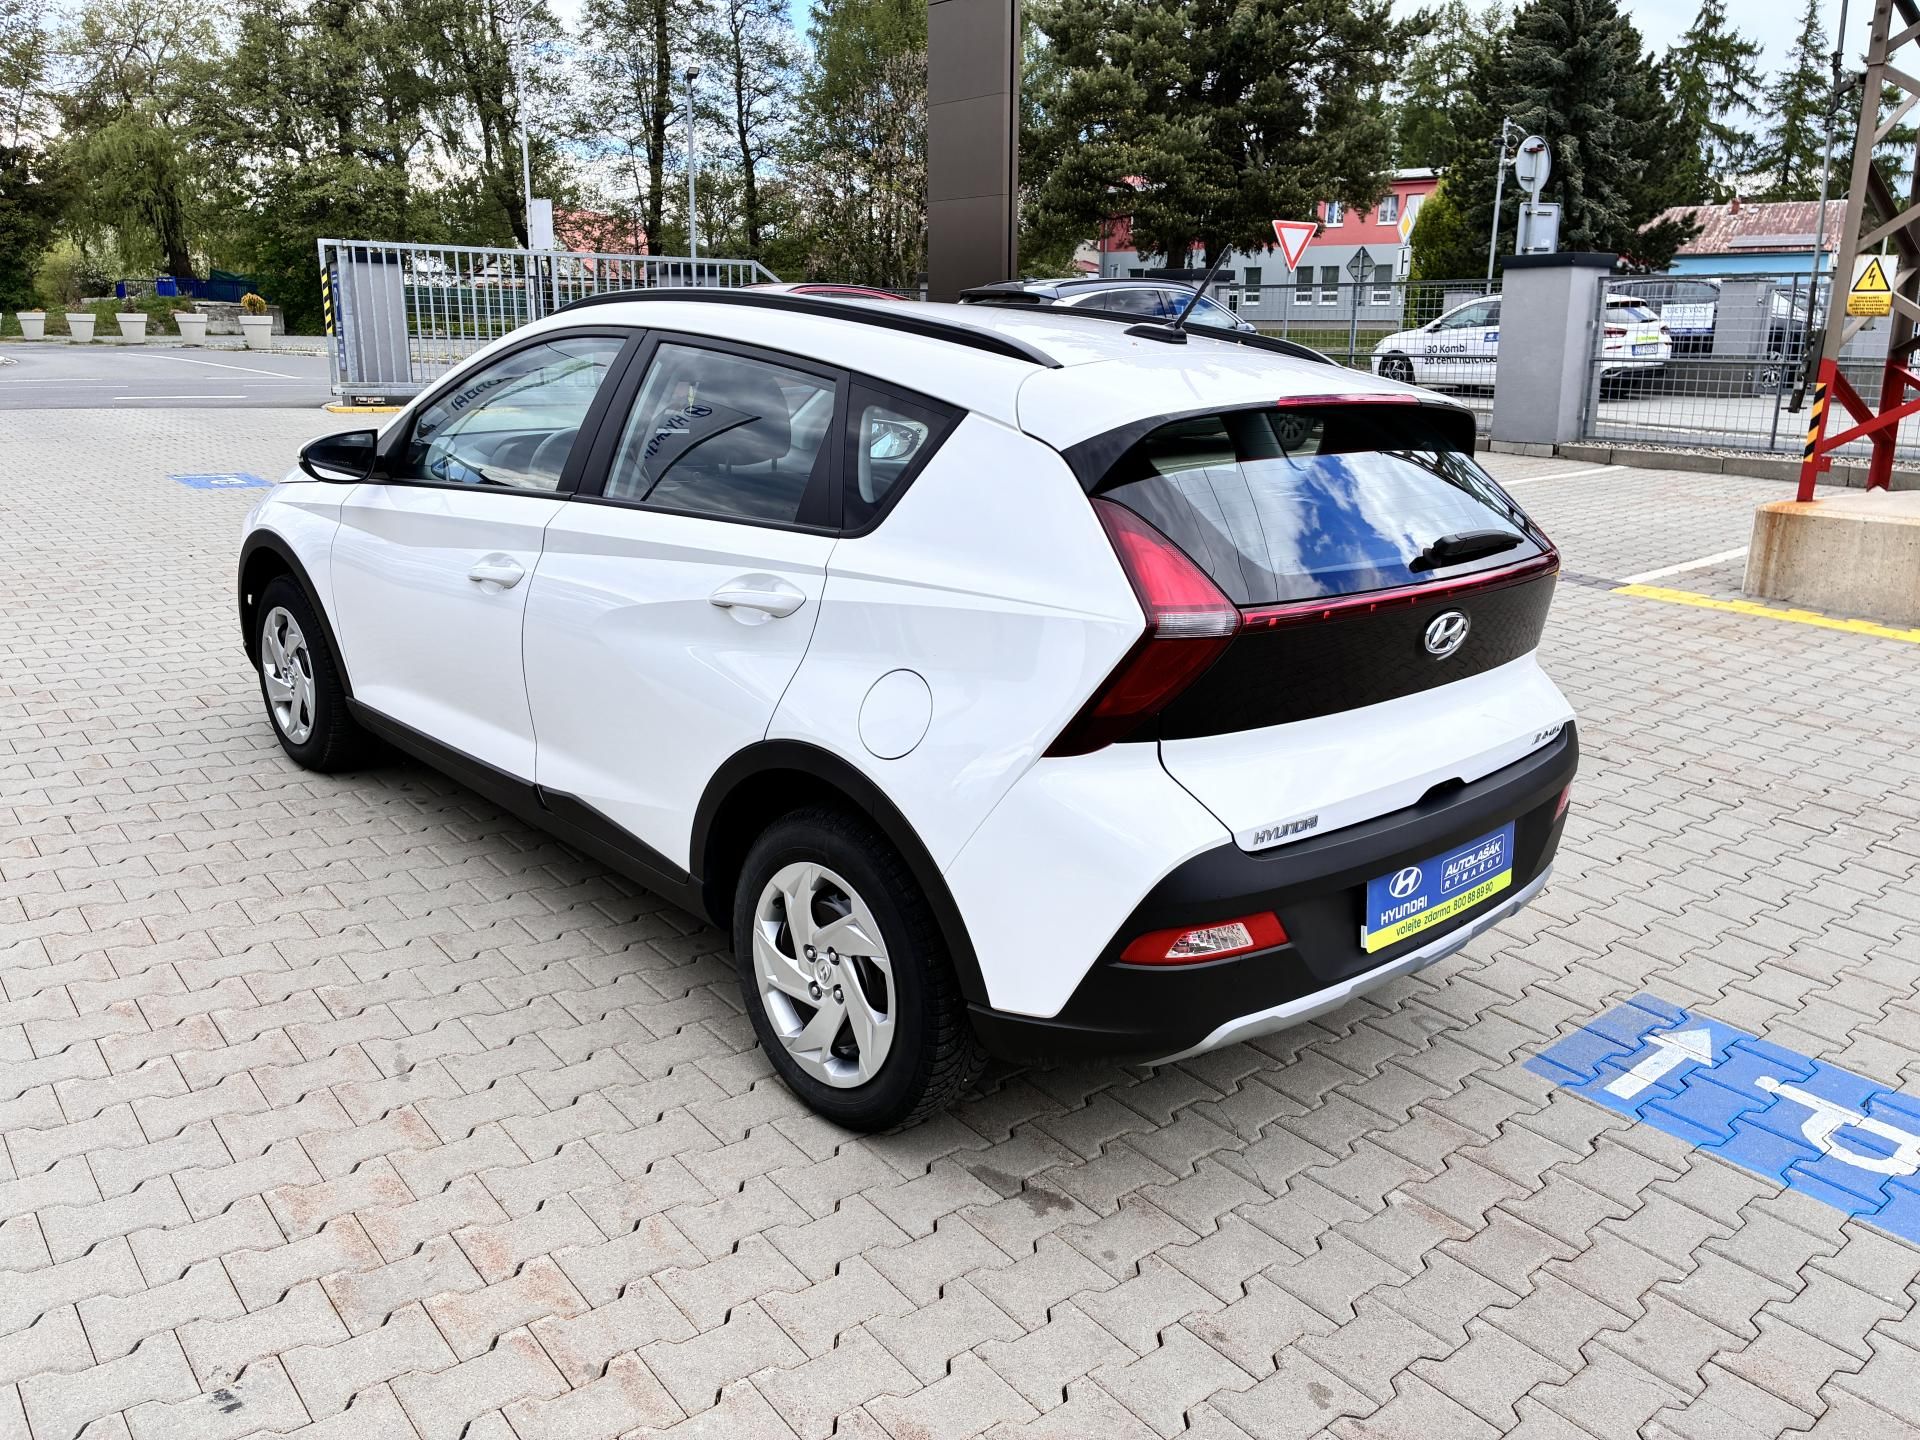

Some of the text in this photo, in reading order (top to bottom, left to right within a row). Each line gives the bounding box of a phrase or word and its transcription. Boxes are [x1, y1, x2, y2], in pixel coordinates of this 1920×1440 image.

[1253, 814, 1319, 845] HYUNDAI
[1444, 840, 1502, 877] AUTOLAŠÁK
[1444, 856, 1501, 890] RÝMAŘOV
[1380, 895, 1428, 926] HYUNDAI
[1396, 881, 1494, 936] volejte zdarma 800 88 89 90
